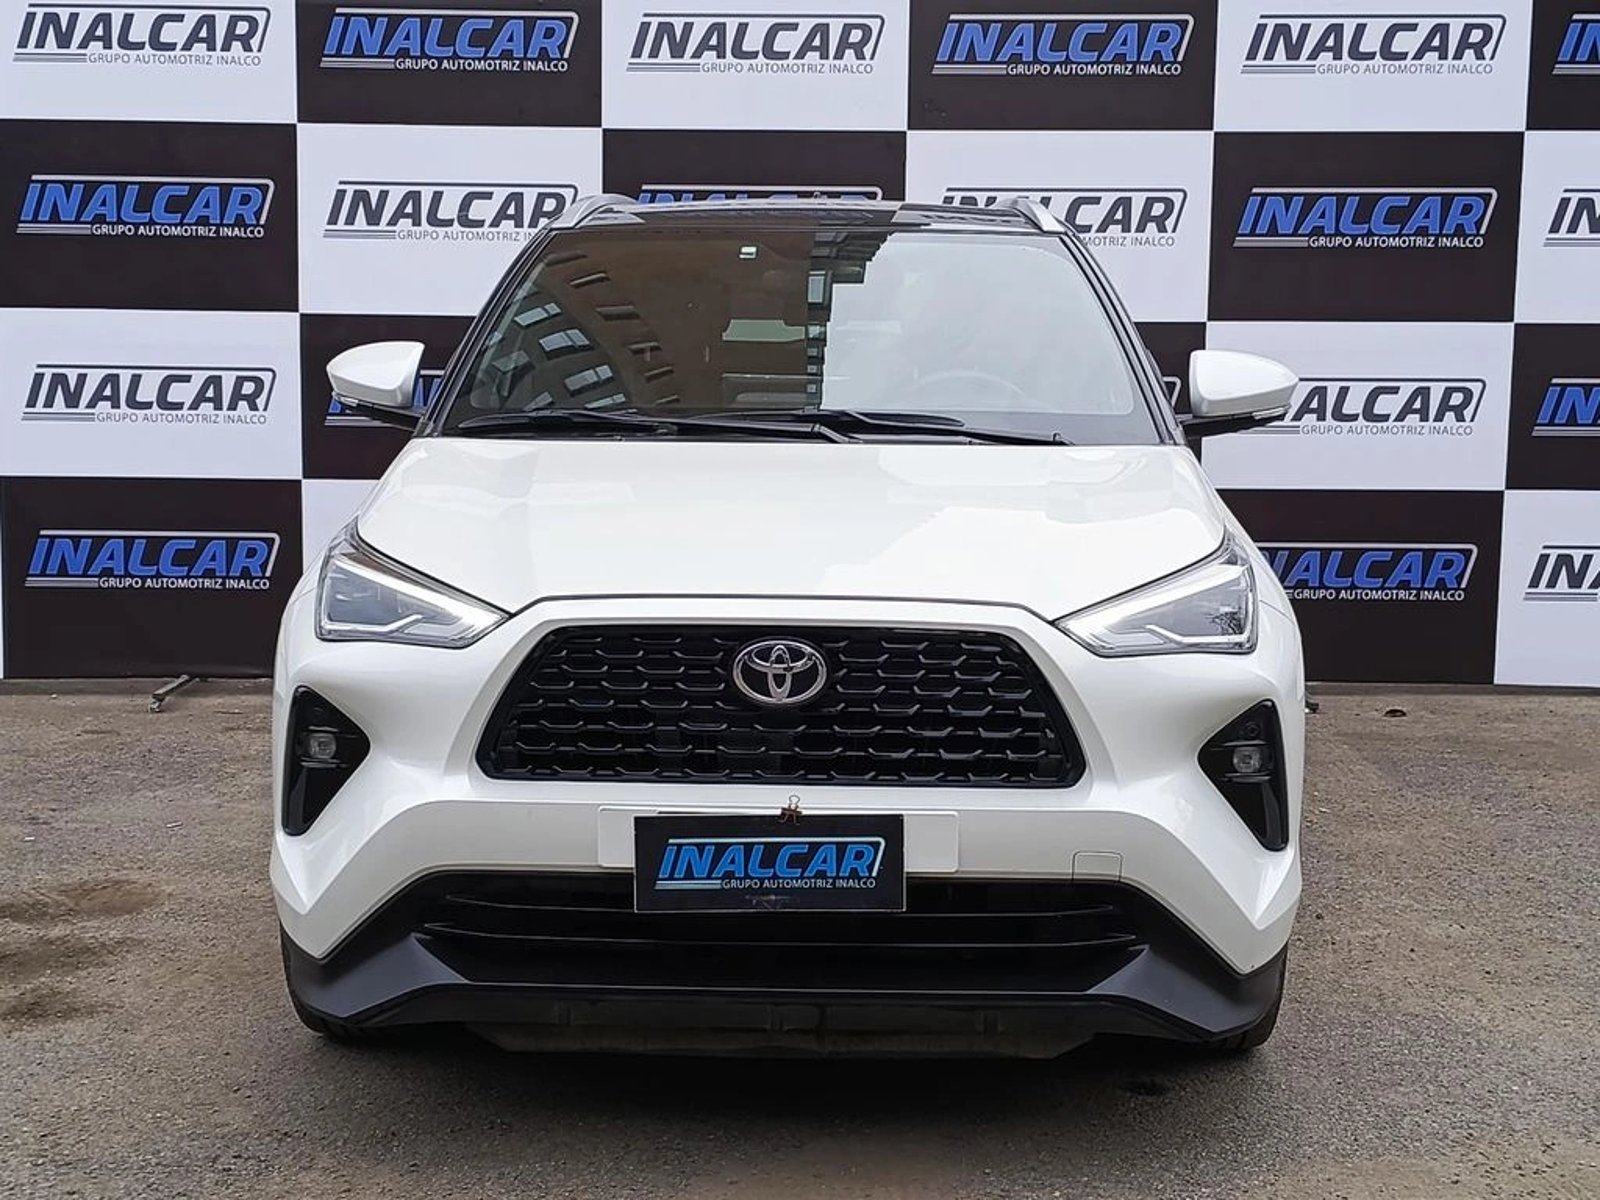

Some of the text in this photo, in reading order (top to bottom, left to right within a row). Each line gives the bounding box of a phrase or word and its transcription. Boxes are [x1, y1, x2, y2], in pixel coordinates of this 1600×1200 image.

[16, 10, 257, 52] INALCAR
[322, 17, 567, 59] INALCAR
[630, 20, 872, 60] INALCAR
[935, 21, 1181, 62] INALCAR
[1245, 22, 1494, 61] INALCAR
[88, 52, 262, 67] GRUPO AUTOMOTRIZ INALCO
[395, 58, 569, 73] GRUPO AUTOMOTRIZ INALCO
[701, 62, 874, 74] GRUPO AUTOMOTRIZ INALCO
[1006, 63, 1182, 76] GRUPO AUTOMOTRIZ INALCO
[1316, 63, 1494, 75] GRUPO AUTOMOTRIZ INALCO
[20, 183, 263, 225] INALCAR
[325, 189, 567, 229] INALCAR
[1237, 196, 1485, 235] INALCAR
[91, 224, 264, 239] GRUPO AUTOMOTRIZ INALCO
[397, 229, 441, 241] GRUPO
[442, 229, 523, 242] AUTOMOTRIZ
[1083, 236, 1176, 247] MOTRIZ INALCO
[1308, 236, 1485, 248] GRUPO AUTOMOTRIZ INALCO
[25, 372, 266, 412] INALCAR
[1290, 385, 1475, 423] ALCAR
[96, 412, 268, 426] GRUPO AUTOMOTRIZ INALCO
[1301, 425, 1473, 437] GRUPO AUTOMOTRIZ INALCO
[28, 537, 272, 577] INALCAR
[99, 577, 271, 590] GRUPO AUTOMOTRIZ INALCO
[1293, 588, 1465, 601] GRUPO AUTOMOTRIZ INALCO
[658, 844, 875, 879] INALCAR
[722, 877, 876, 889] GRUPO AUTOMOTRIZ INALCO
